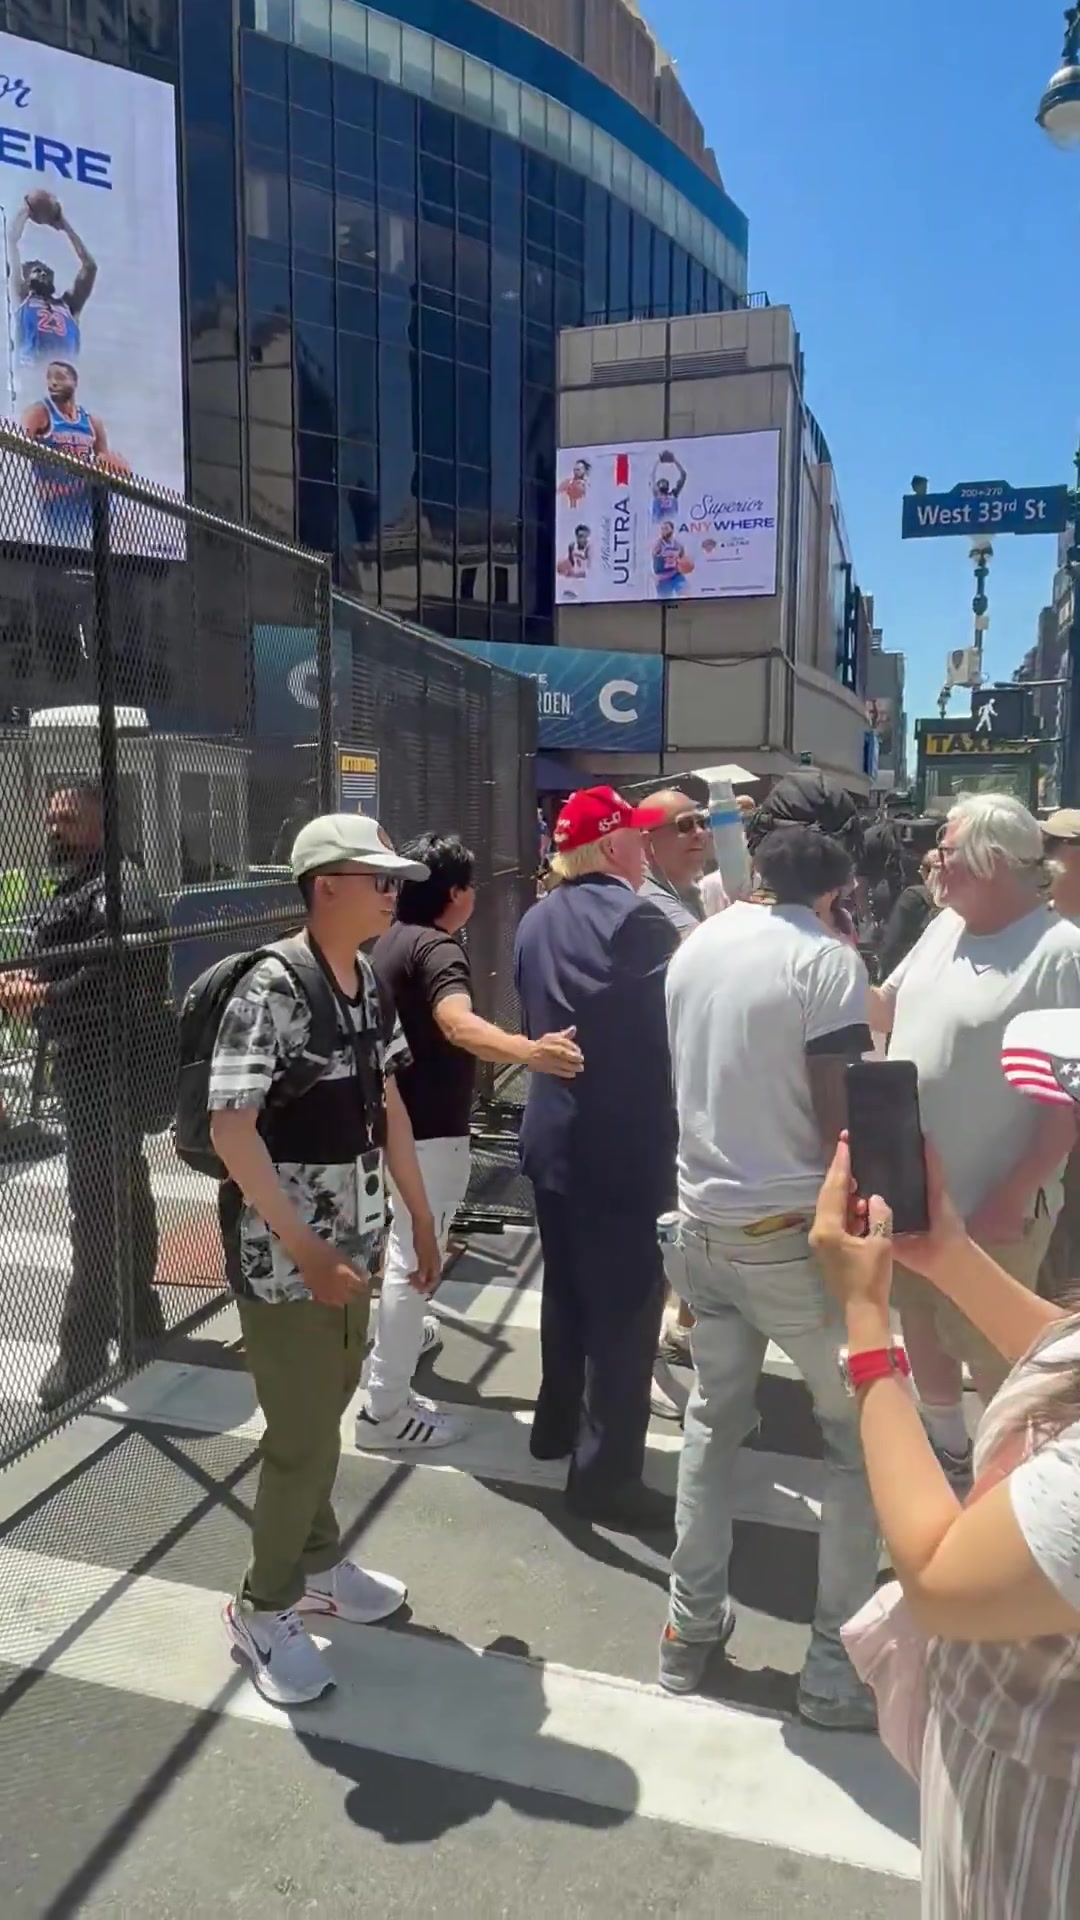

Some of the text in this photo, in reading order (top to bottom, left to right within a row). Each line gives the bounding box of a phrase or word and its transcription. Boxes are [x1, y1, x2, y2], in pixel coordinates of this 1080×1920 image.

[690, 494, 764, 520] Superior
[917, 498, 1047, 525] West 33rd St
[613, 496, 630, 585] ULTRA
[599, 680, 638, 723] C
